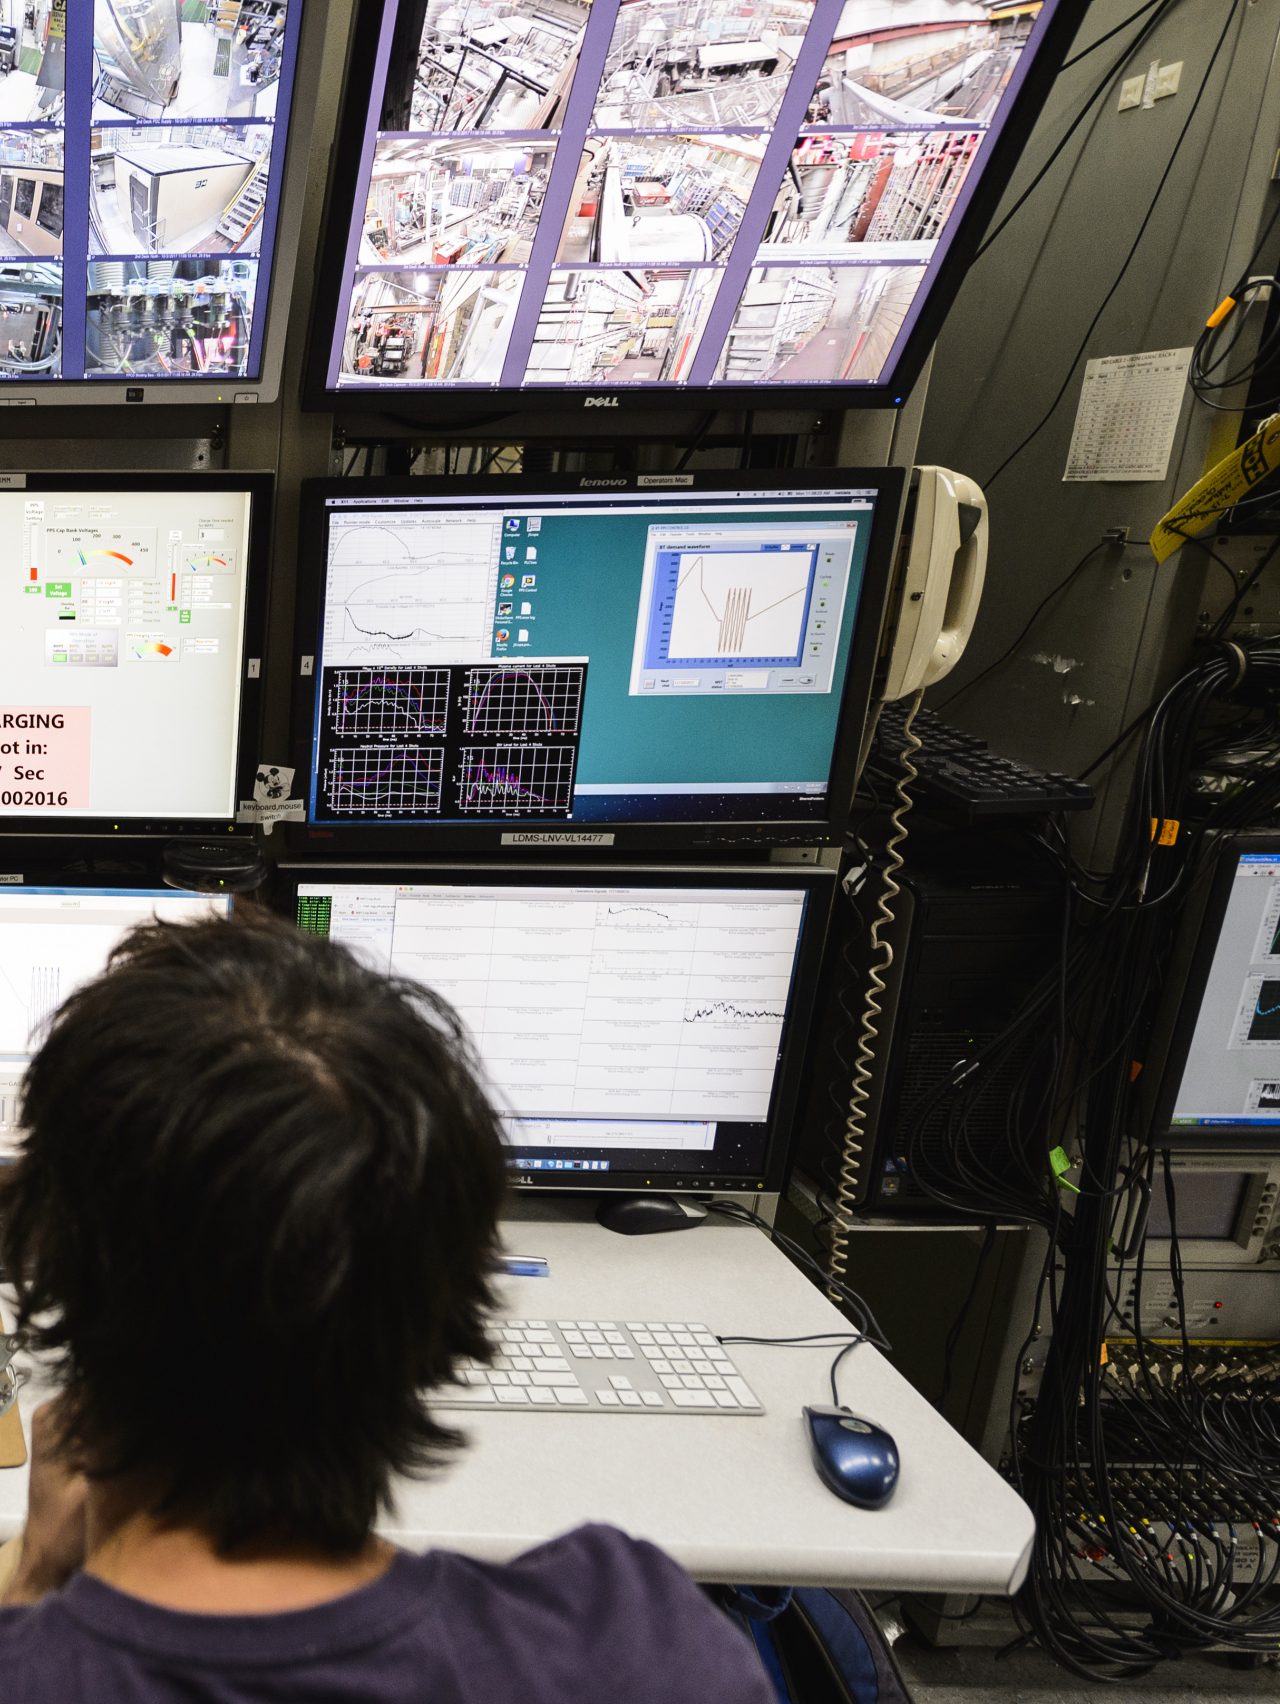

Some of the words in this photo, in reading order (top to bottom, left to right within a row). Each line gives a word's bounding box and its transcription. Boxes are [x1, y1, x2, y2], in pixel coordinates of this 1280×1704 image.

[584, 396, 619, 407] DELL
[579, 477, 627, 488] lenovo
[643, 476, 673, 485] Operators
[251, 664, 256, 672] 1
[25, 739, 48, 755] in:
[13, 765, 45, 780] Sec
[243, 803, 302, 811] keyboard,mouse
[512, 834, 604, 844] LDMS-LNV-VL14477
